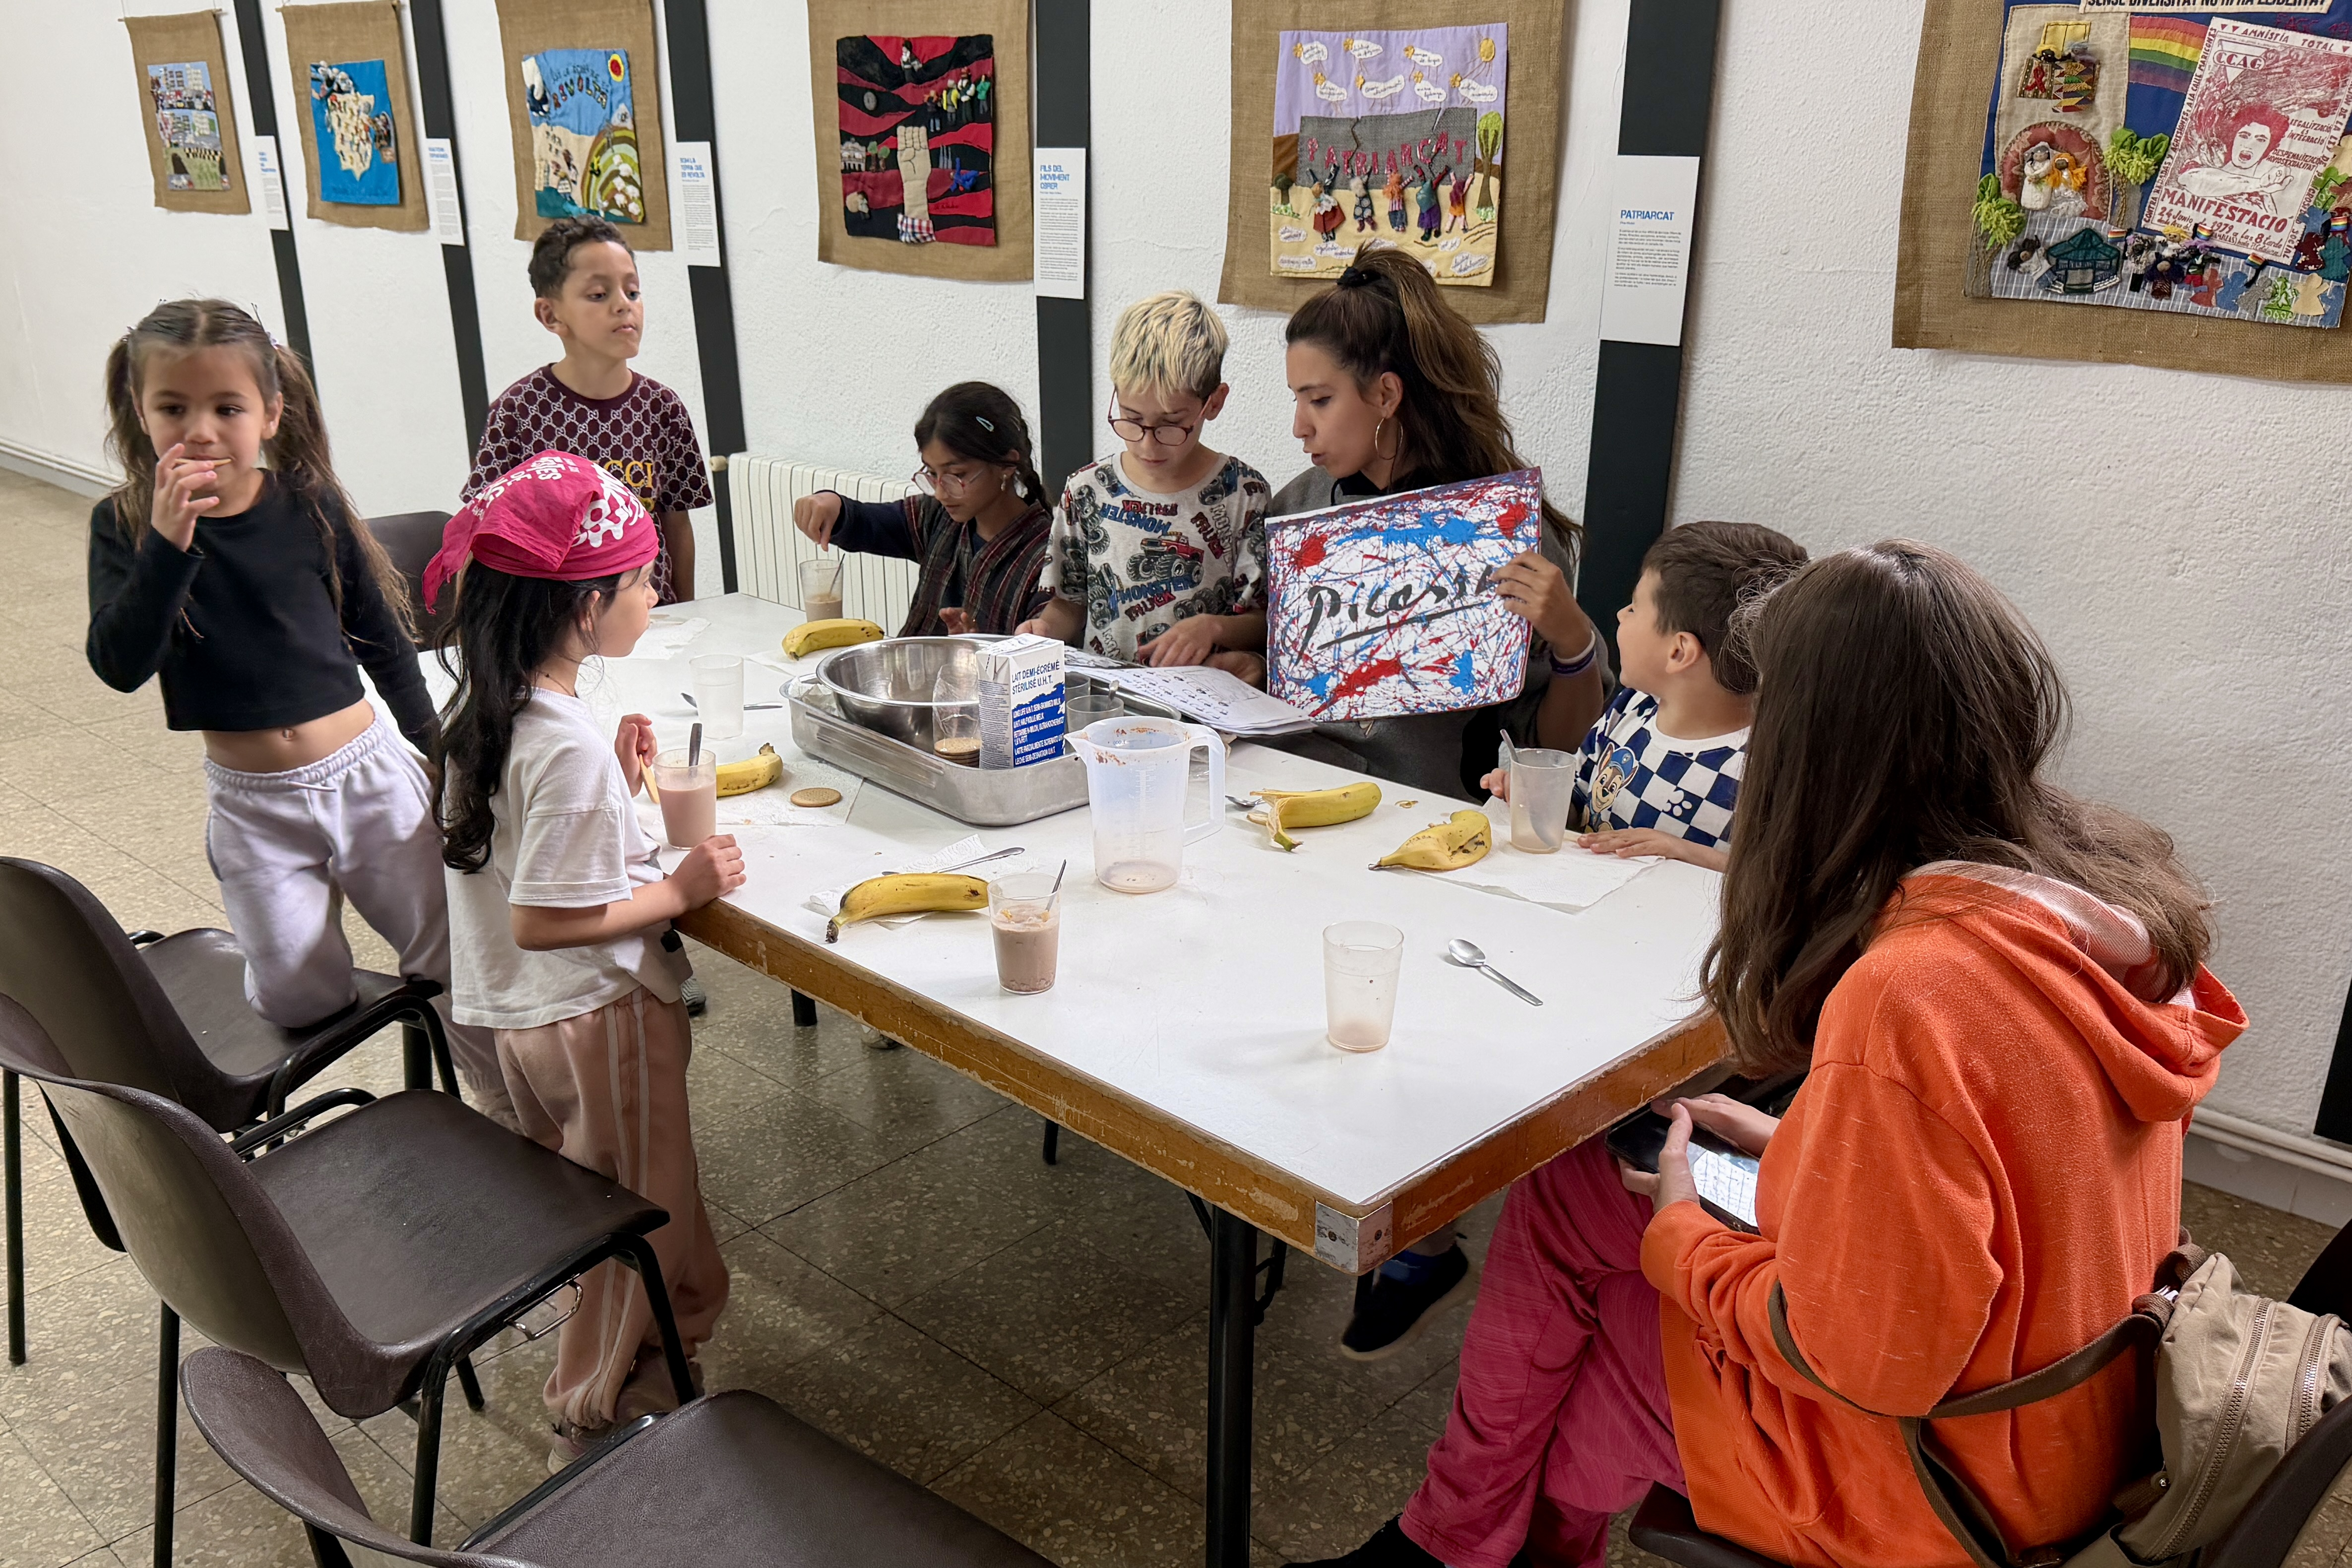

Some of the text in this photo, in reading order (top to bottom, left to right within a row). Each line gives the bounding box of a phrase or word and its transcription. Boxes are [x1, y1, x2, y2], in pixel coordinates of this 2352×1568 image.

[2301, 39, 2334, 51] TOTAL
[2143, 196, 2158, 223] CONTRA
[2198, 27, 2217, 71] MARICONES
[2333, 120, 2343, 132] LA
[1308, 131, 1468, 176] PATRIARCAT
[1620, 210, 1674, 221] PATRIARCAT
[2158, 206, 2173, 218] 24
[2172, 210, 2193, 223] Junio
[2211, 221, 2234, 234] 1979
[2255, 233, 2264, 244] 8
[2161, 188, 2293, 233] MANIFESTACIÓ
[2283, 229, 2299, 258] SOCIAL
[1098, 502, 1172, 536] MONSTER
[1122, 500, 1178, 516] TRUCK
[1119, 574, 1196, 604] MONSTER
[1125, 591, 1177, 622] TRUCK
[1012, 659, 1060, 683] LAIT DEMI-ÉCRÉMÉ
[1012, 675, 1053, 694] STÉRILISÉ U.H.T.
